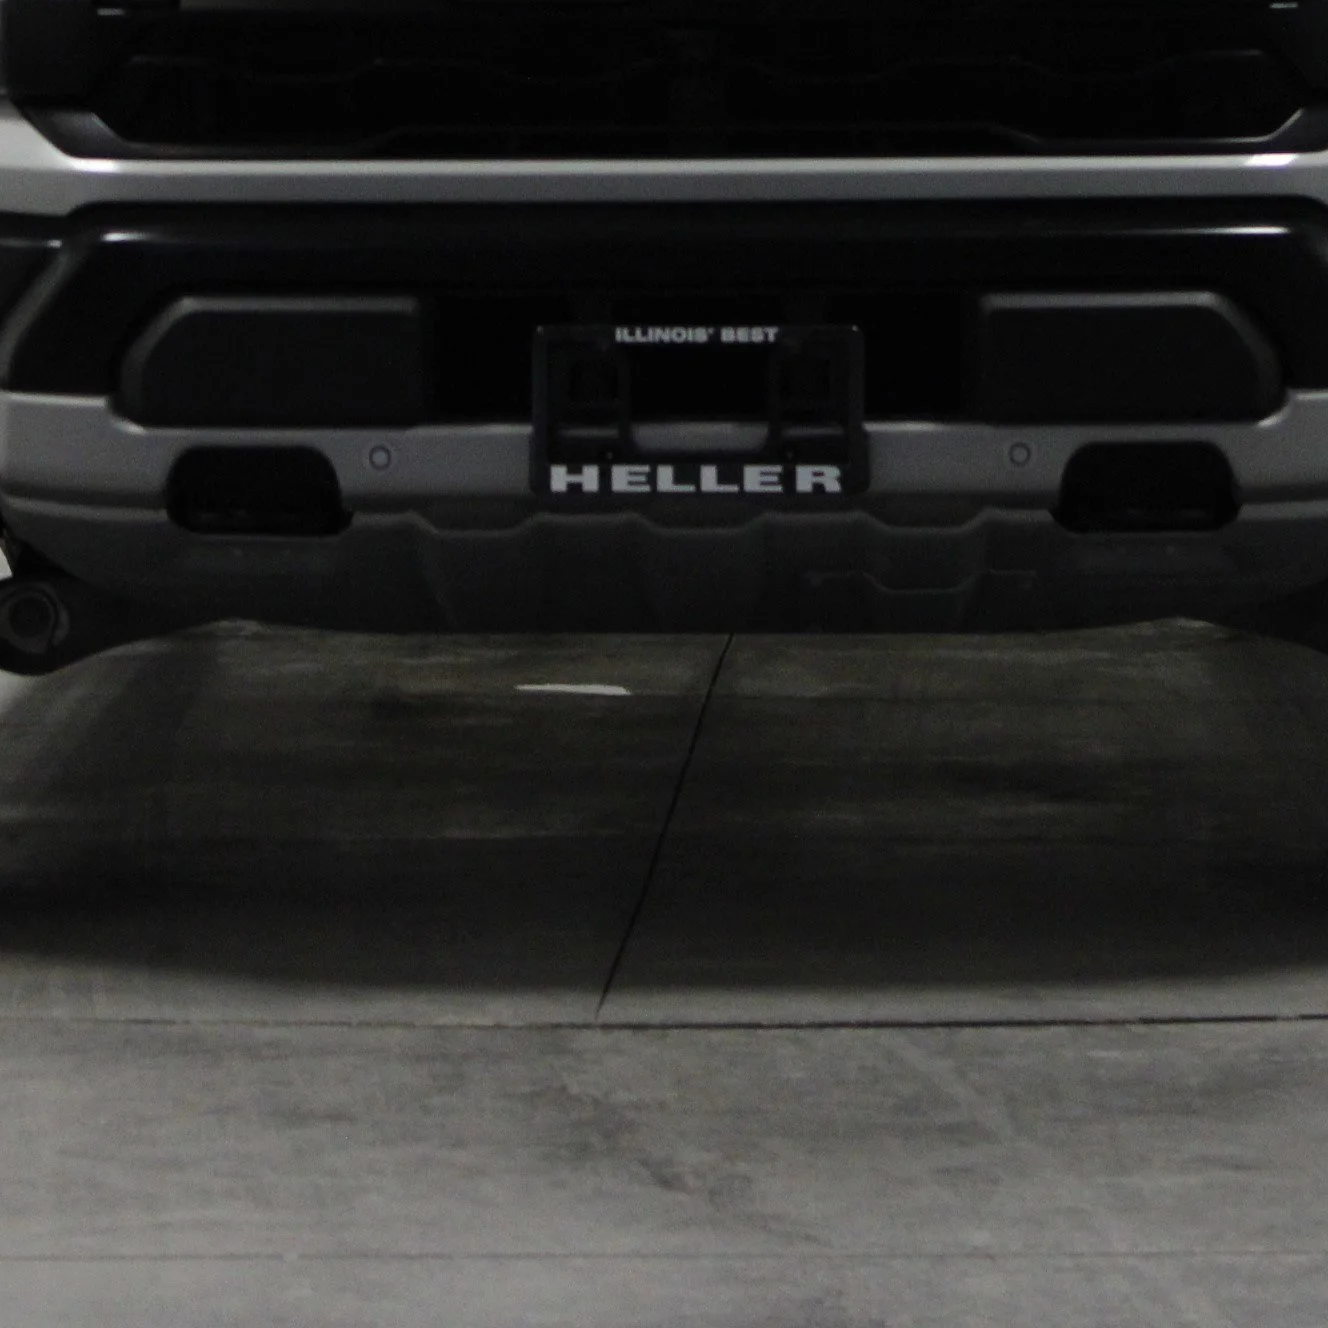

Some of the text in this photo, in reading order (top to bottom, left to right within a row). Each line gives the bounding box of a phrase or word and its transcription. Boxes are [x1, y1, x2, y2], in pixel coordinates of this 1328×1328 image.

[614, 325, 779, 344] ILLINOIS' BEST
[548, 463, 842, 494] HELLER
